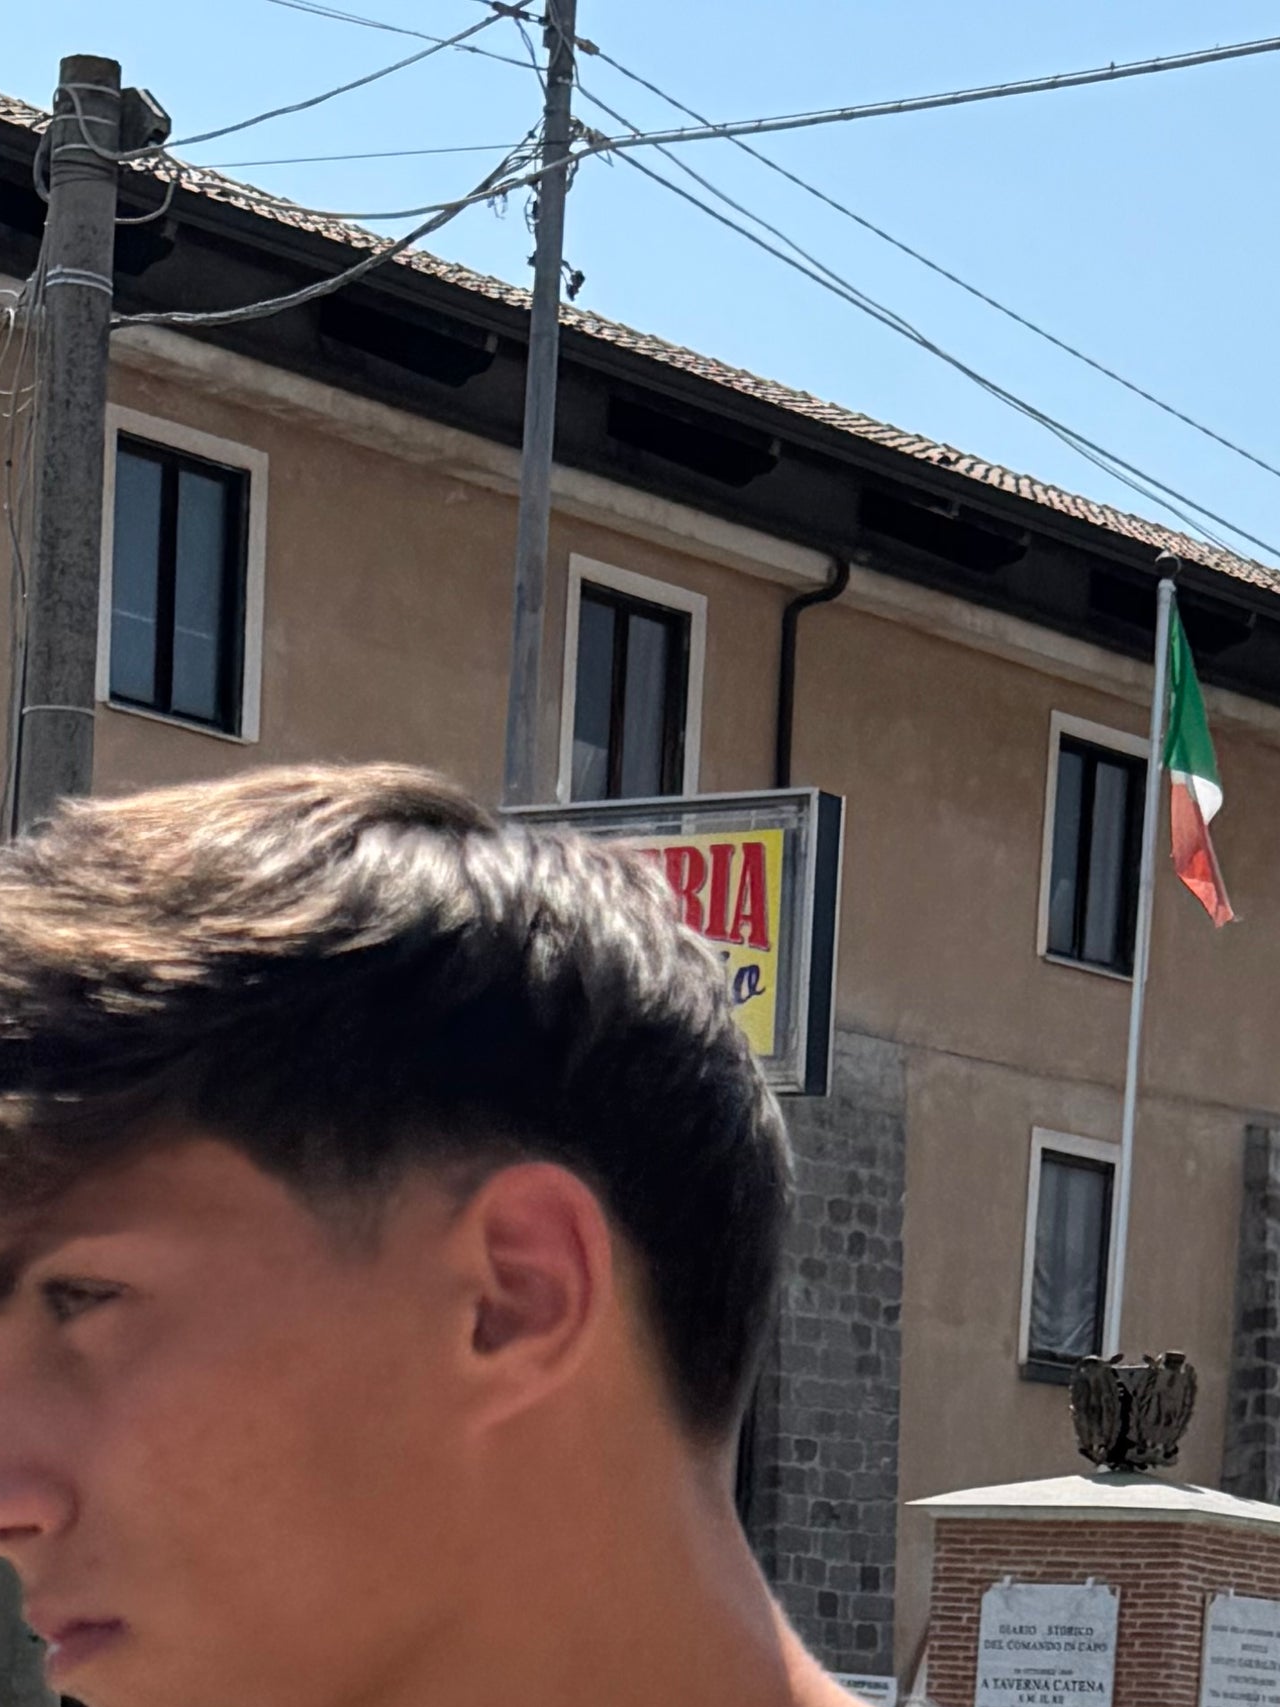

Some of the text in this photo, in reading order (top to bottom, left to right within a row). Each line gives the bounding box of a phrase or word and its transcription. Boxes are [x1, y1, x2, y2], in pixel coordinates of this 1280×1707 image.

[634, 841, 770, 951] RIA
[999, 1624, 1095, 1637] DIARIO STORICO
[984, 1639, 1109, 1653] DEL COMANDO IN CAPO
[982, 1678, 1106, 1694] A TAVERNA CATENA
